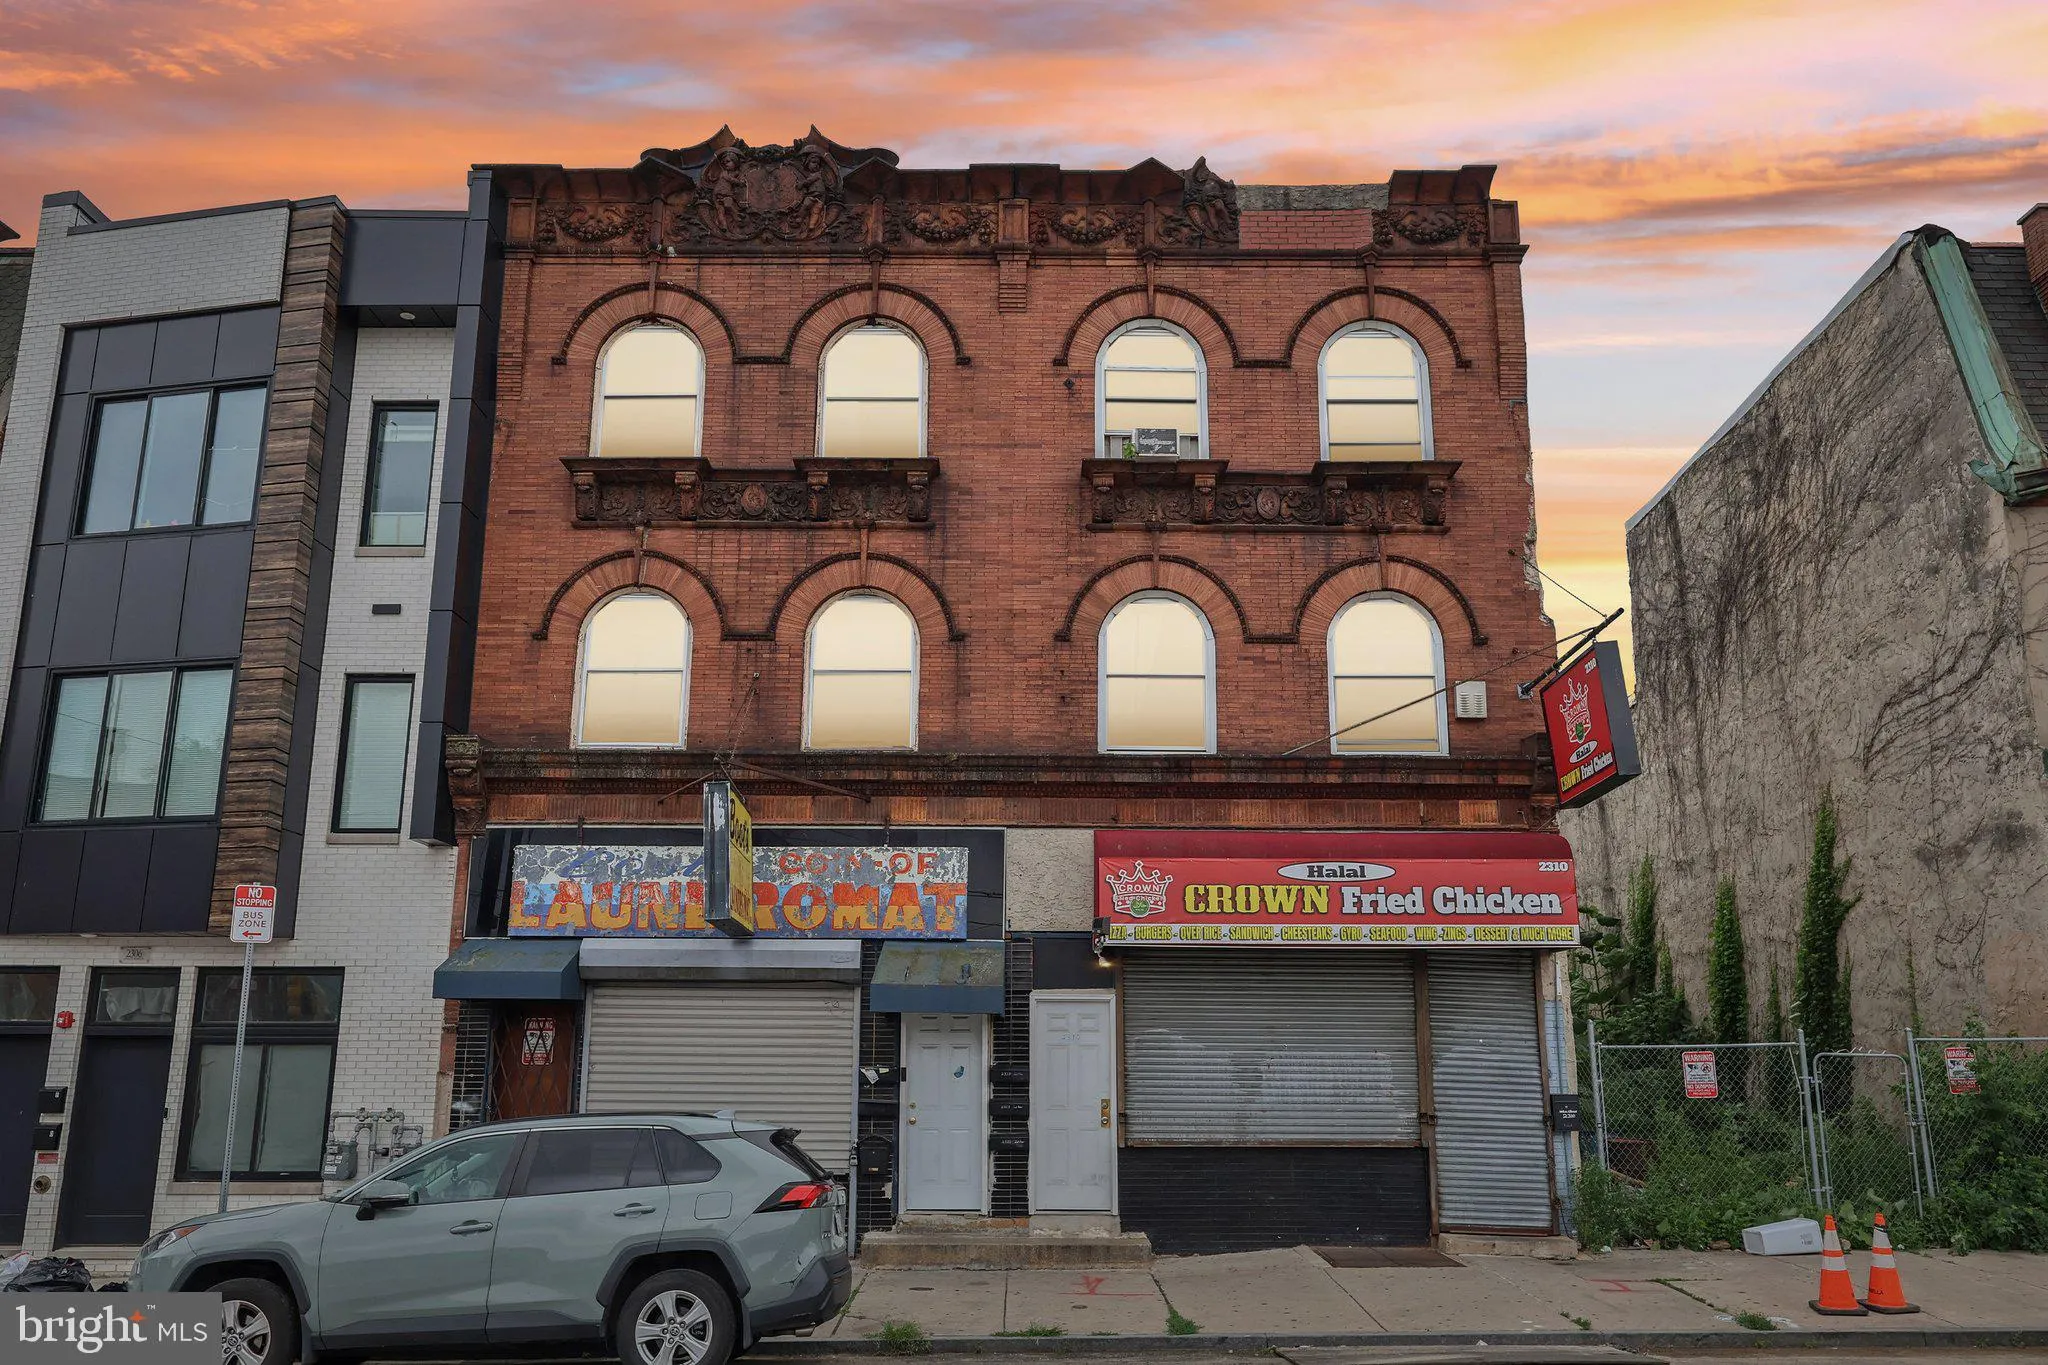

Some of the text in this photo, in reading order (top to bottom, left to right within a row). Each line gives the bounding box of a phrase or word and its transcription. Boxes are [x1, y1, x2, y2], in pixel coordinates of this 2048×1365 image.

[1538, 861, 1569, 872] 2310
[1306, 865, 1367, 879] Halal
[248, 887, 263, 898] NO
[1119, 884, 1160, 893] CROWN
[236, 898, 273, 907] STOPPING
[1185, 884, 1563, 915] CROWN Fried Chicken
[243, 911, 264, 920] BUS
[238, 920, 267, 928] ZONE
[1109, 926, 1128, 941] IZZA
[1134, 926, 1172, 941] BURGERS
[1180, 926, 1203, 941] OVER
[1203, 926, 1222, 941] RICE
[1229, 926, 1274, 941] SANDWICH
[1340, 926, 1362, 941] GYRO
[1370, 926, 1407, 941] SEAFOOD
[1414, 926, 1438, 941] WING
[1474, 926, 1510, 941] DESSERT
[1520, 926, 1545, 941] MUCH
[1684, 1054, 1713, 1062] WARNING
